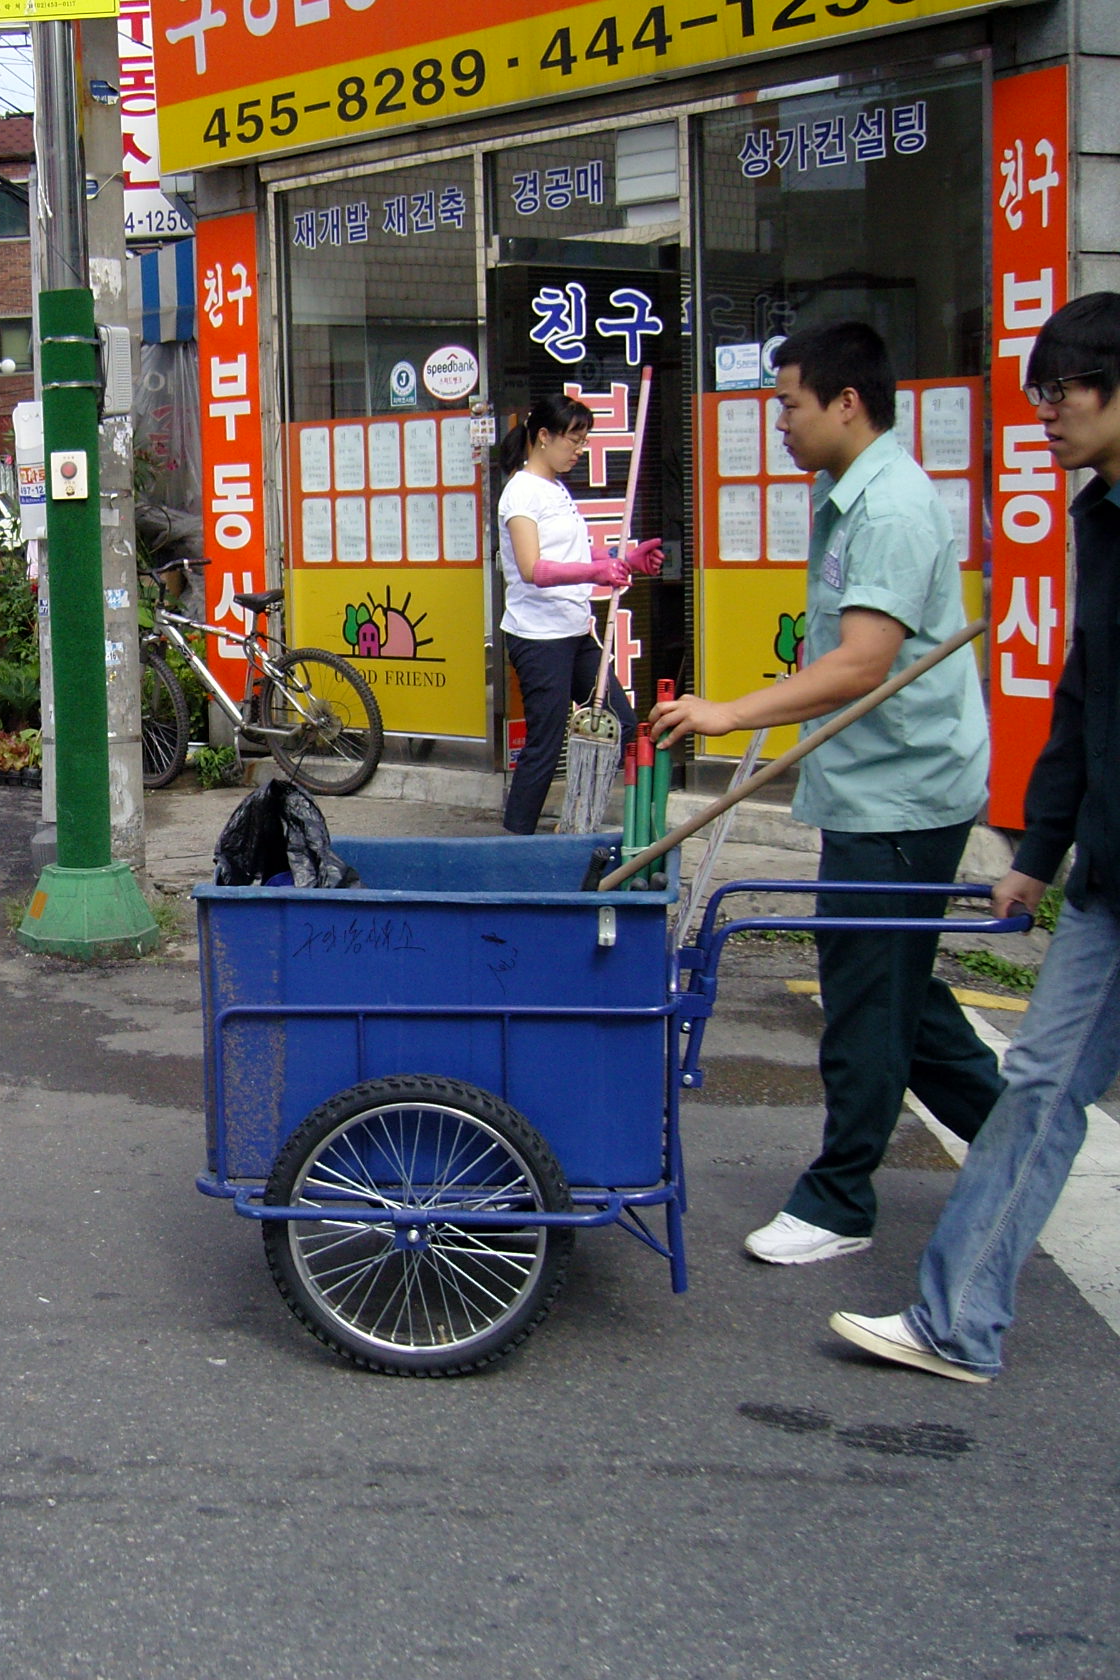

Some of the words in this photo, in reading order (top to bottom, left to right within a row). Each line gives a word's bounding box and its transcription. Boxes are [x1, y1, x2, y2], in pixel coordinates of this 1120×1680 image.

[202, 49, 486, 149] 455-8289
[539, 0, 914, 76] 444-12
[738, 101, 928, 178] 상가컨설팅
[293, 201, 370, 249] 재개발
[382, 186, 467, 237] 재건축
[511, 159, 604, 215] 경공매
[999, 138, 1060, 231] 친구
[203, 262, 253, 329] 친구
[529, 281, 663, 366] 친구
[426, 358, 475, 378] speedbank
[208, 353, 255, 660] 부동산
[998, 267, 1057, 698] 부동산
[385, 670, 447, 688] FRIEND
